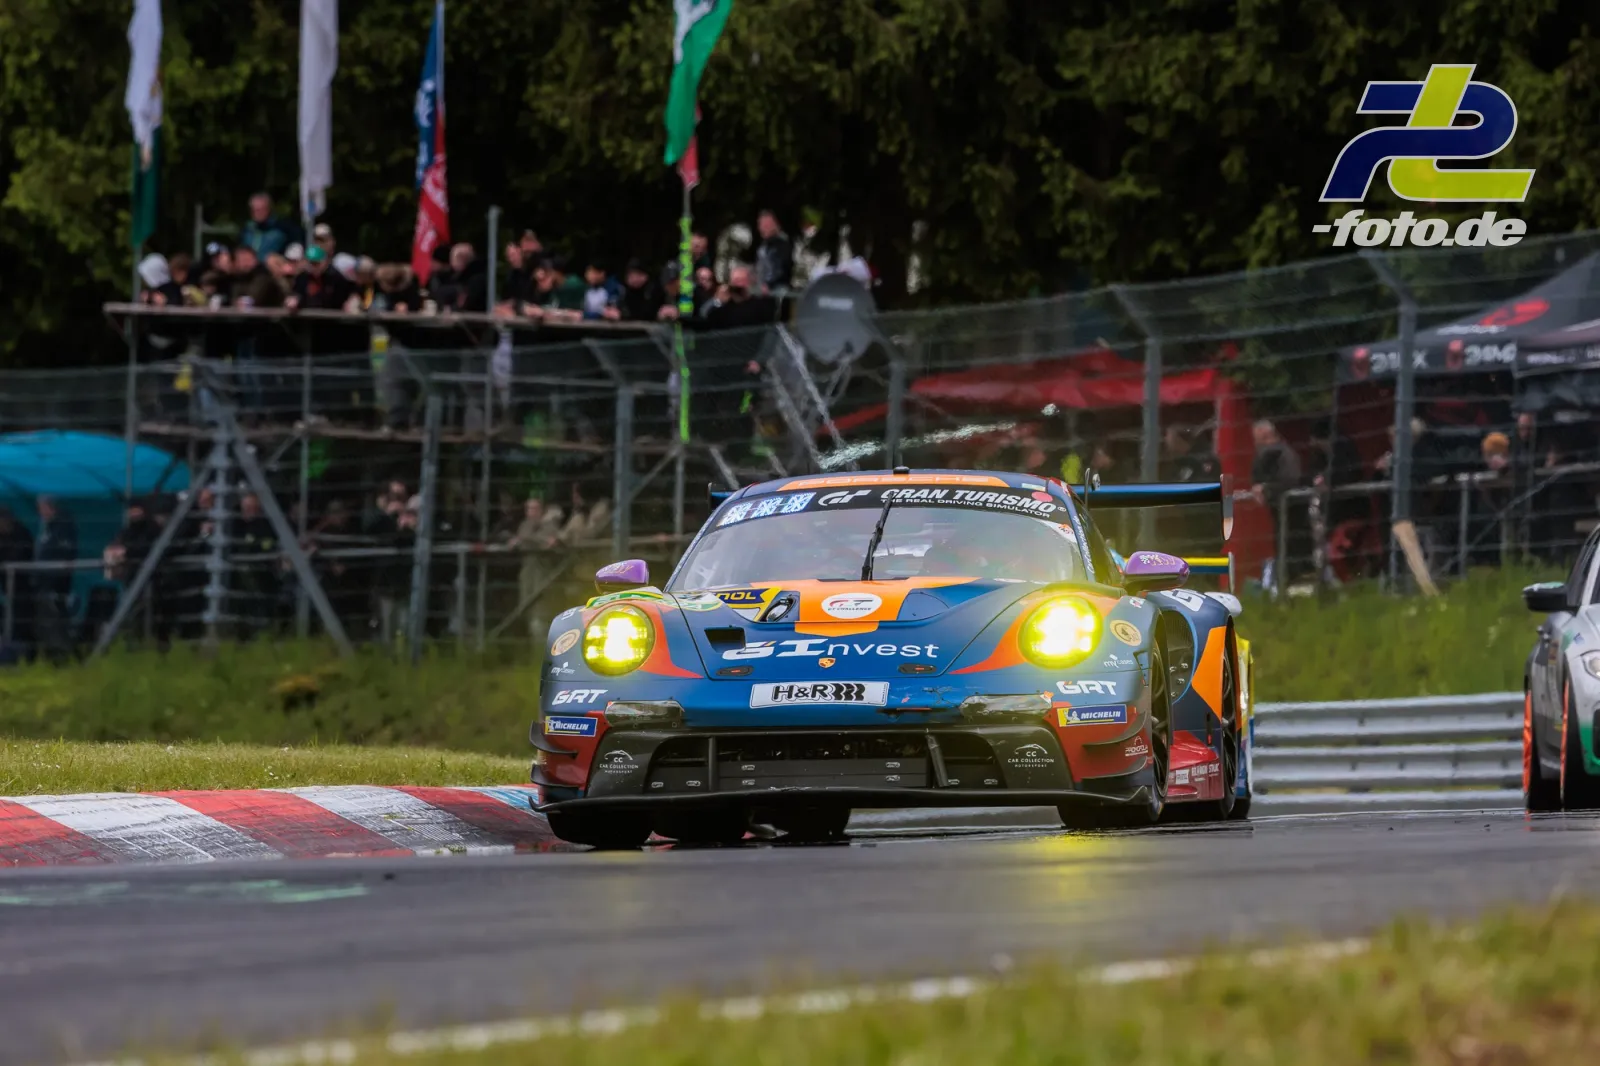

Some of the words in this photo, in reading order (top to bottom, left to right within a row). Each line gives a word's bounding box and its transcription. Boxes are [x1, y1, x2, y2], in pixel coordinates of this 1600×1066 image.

[880, 488, 949, 499] GRAN
[953, 489, 1057, 513] TURISMO
[937, 499, 983, 507] DRIVING
[985, 502, 1051, 518] SIMULATOR
[1055, 680, 1117, 696] GRT
[551, 688, 609, 706] GRT
[1080, 710, 1121, 719] MICHELIN
[554, 722, 589, 731] MICHELIN
